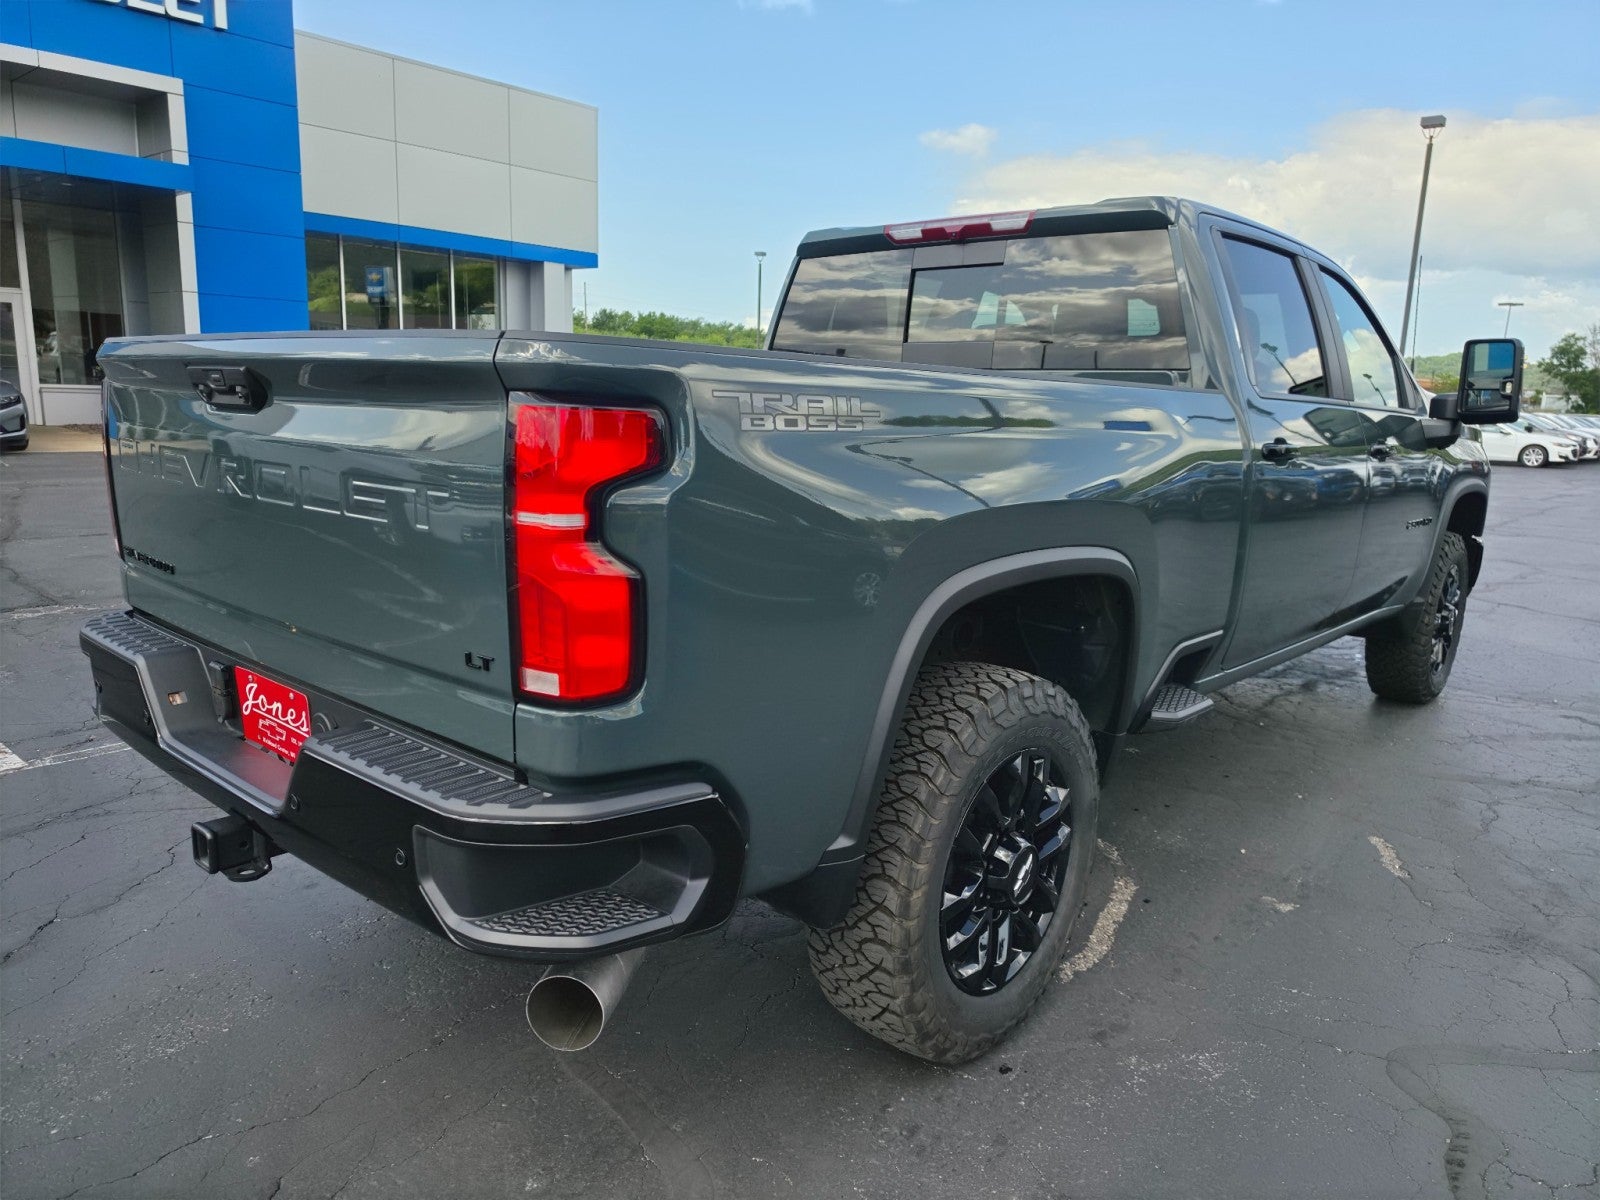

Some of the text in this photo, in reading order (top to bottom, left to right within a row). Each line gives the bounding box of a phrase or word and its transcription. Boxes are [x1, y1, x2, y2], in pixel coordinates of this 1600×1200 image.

[711, 389, 881, 418] TRAIL
[740, 413, 864, 432] BOSS
[118, 438, 450, 530] CHEVROLET
[464, 652, 495, 672] LT
[242, 682, 309, 732] Jones
